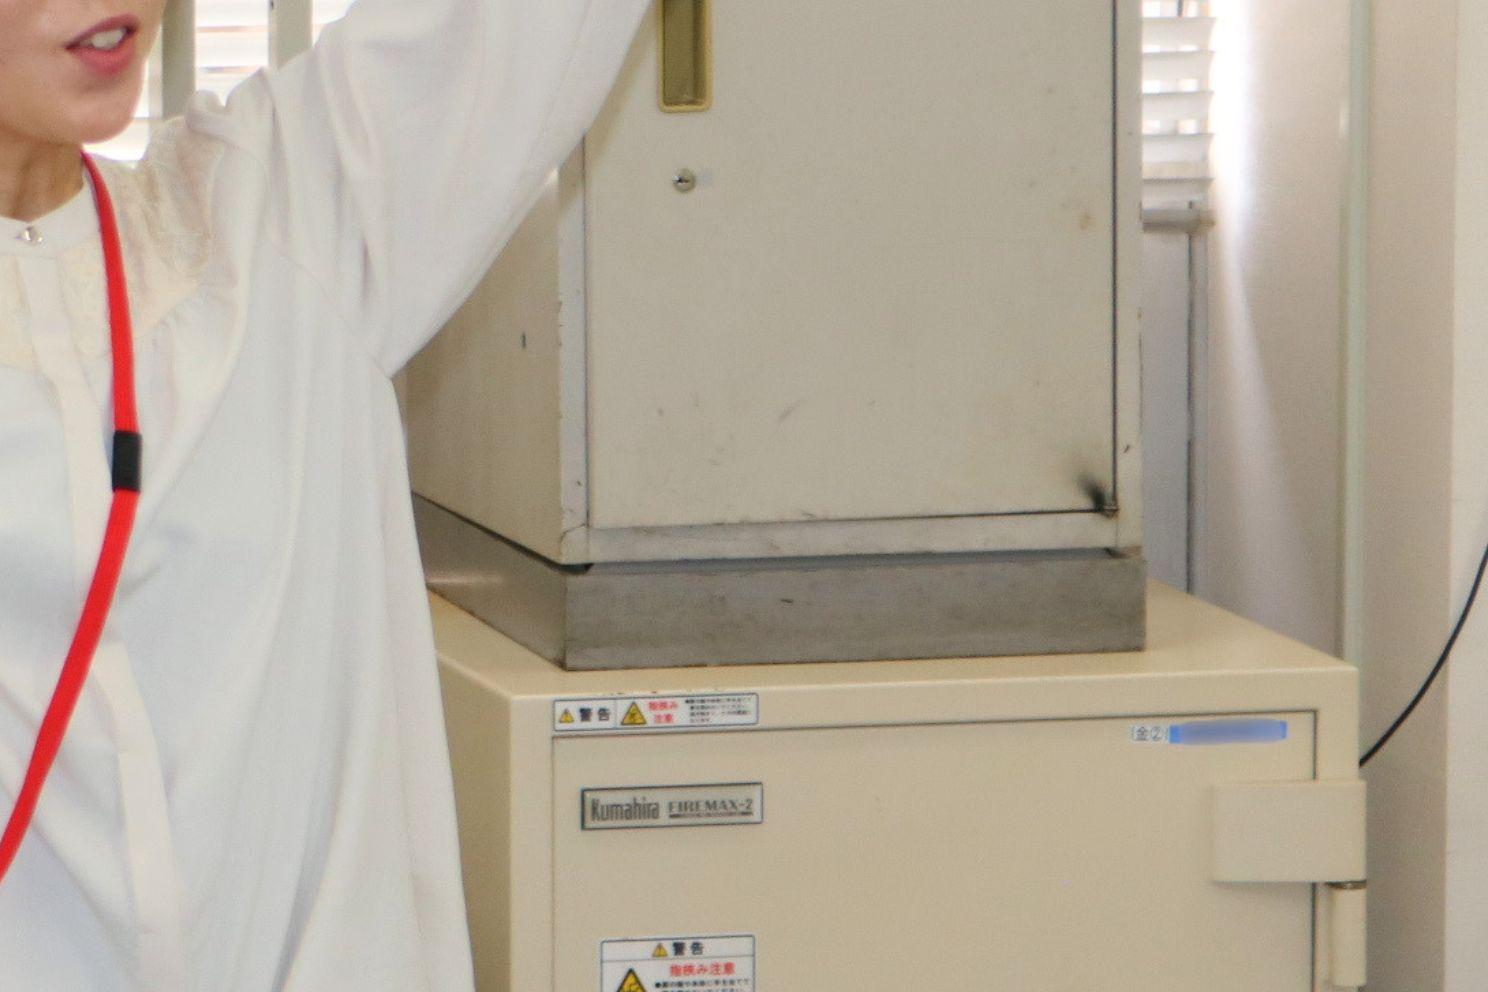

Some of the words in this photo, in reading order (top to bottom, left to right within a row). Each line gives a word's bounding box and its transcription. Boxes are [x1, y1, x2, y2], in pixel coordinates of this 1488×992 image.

[591, 796, 660, 821] Kumahira
[668, 798, 754, 812] FIREMAX-2
[672, 941, 704, 956] 警告
